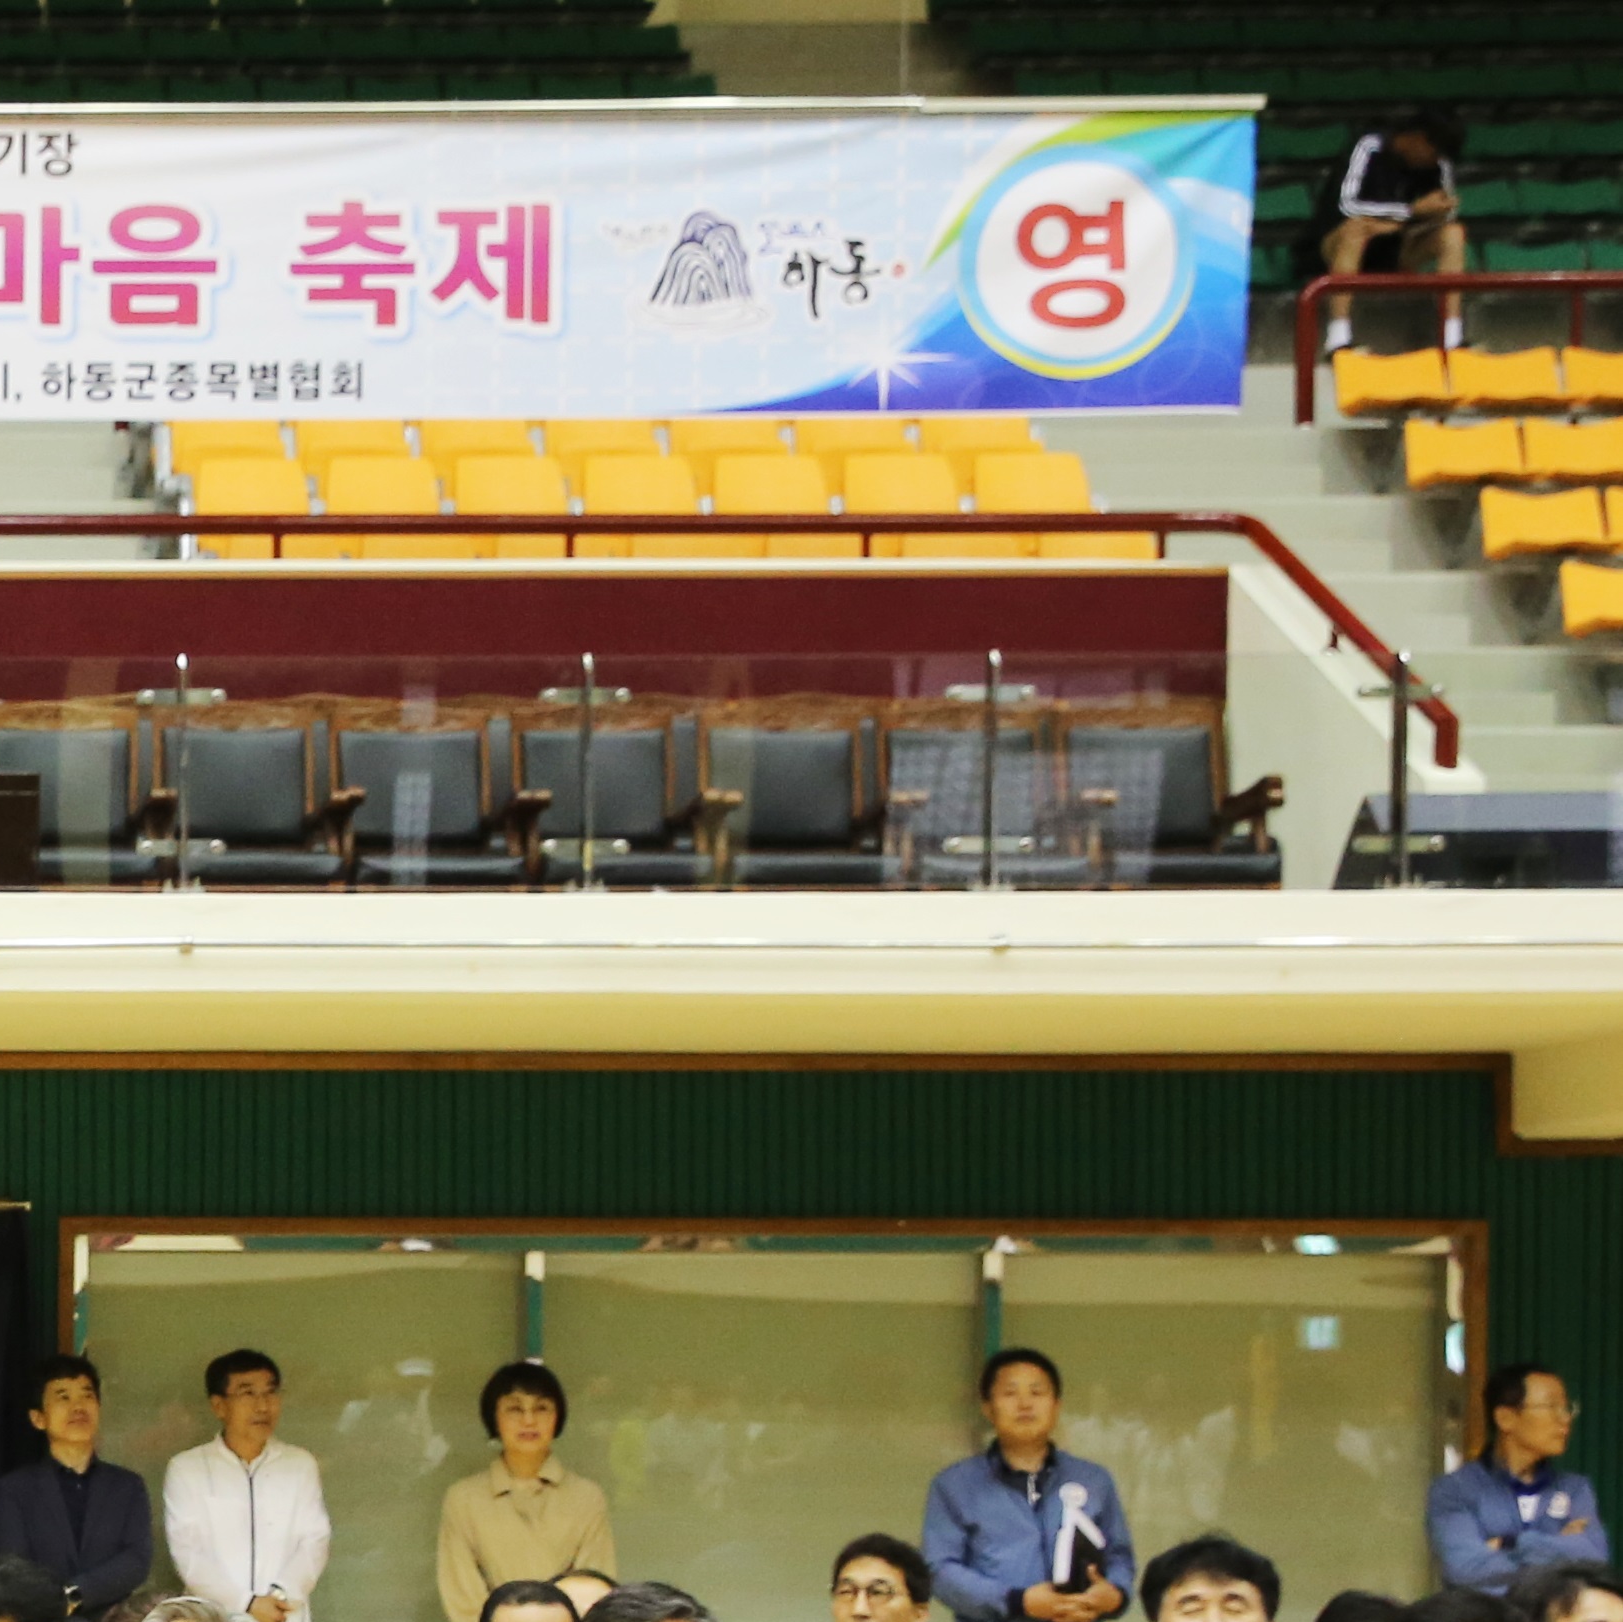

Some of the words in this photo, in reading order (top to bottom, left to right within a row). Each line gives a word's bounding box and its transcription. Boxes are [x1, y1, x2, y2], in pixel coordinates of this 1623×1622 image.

[289, 201, 551, 327] 축제
[783, 240, 881, 319] 하동
[1015, 198, 1127, 330] 영
[42, 362, 362, 401] 하동군종목별협회
